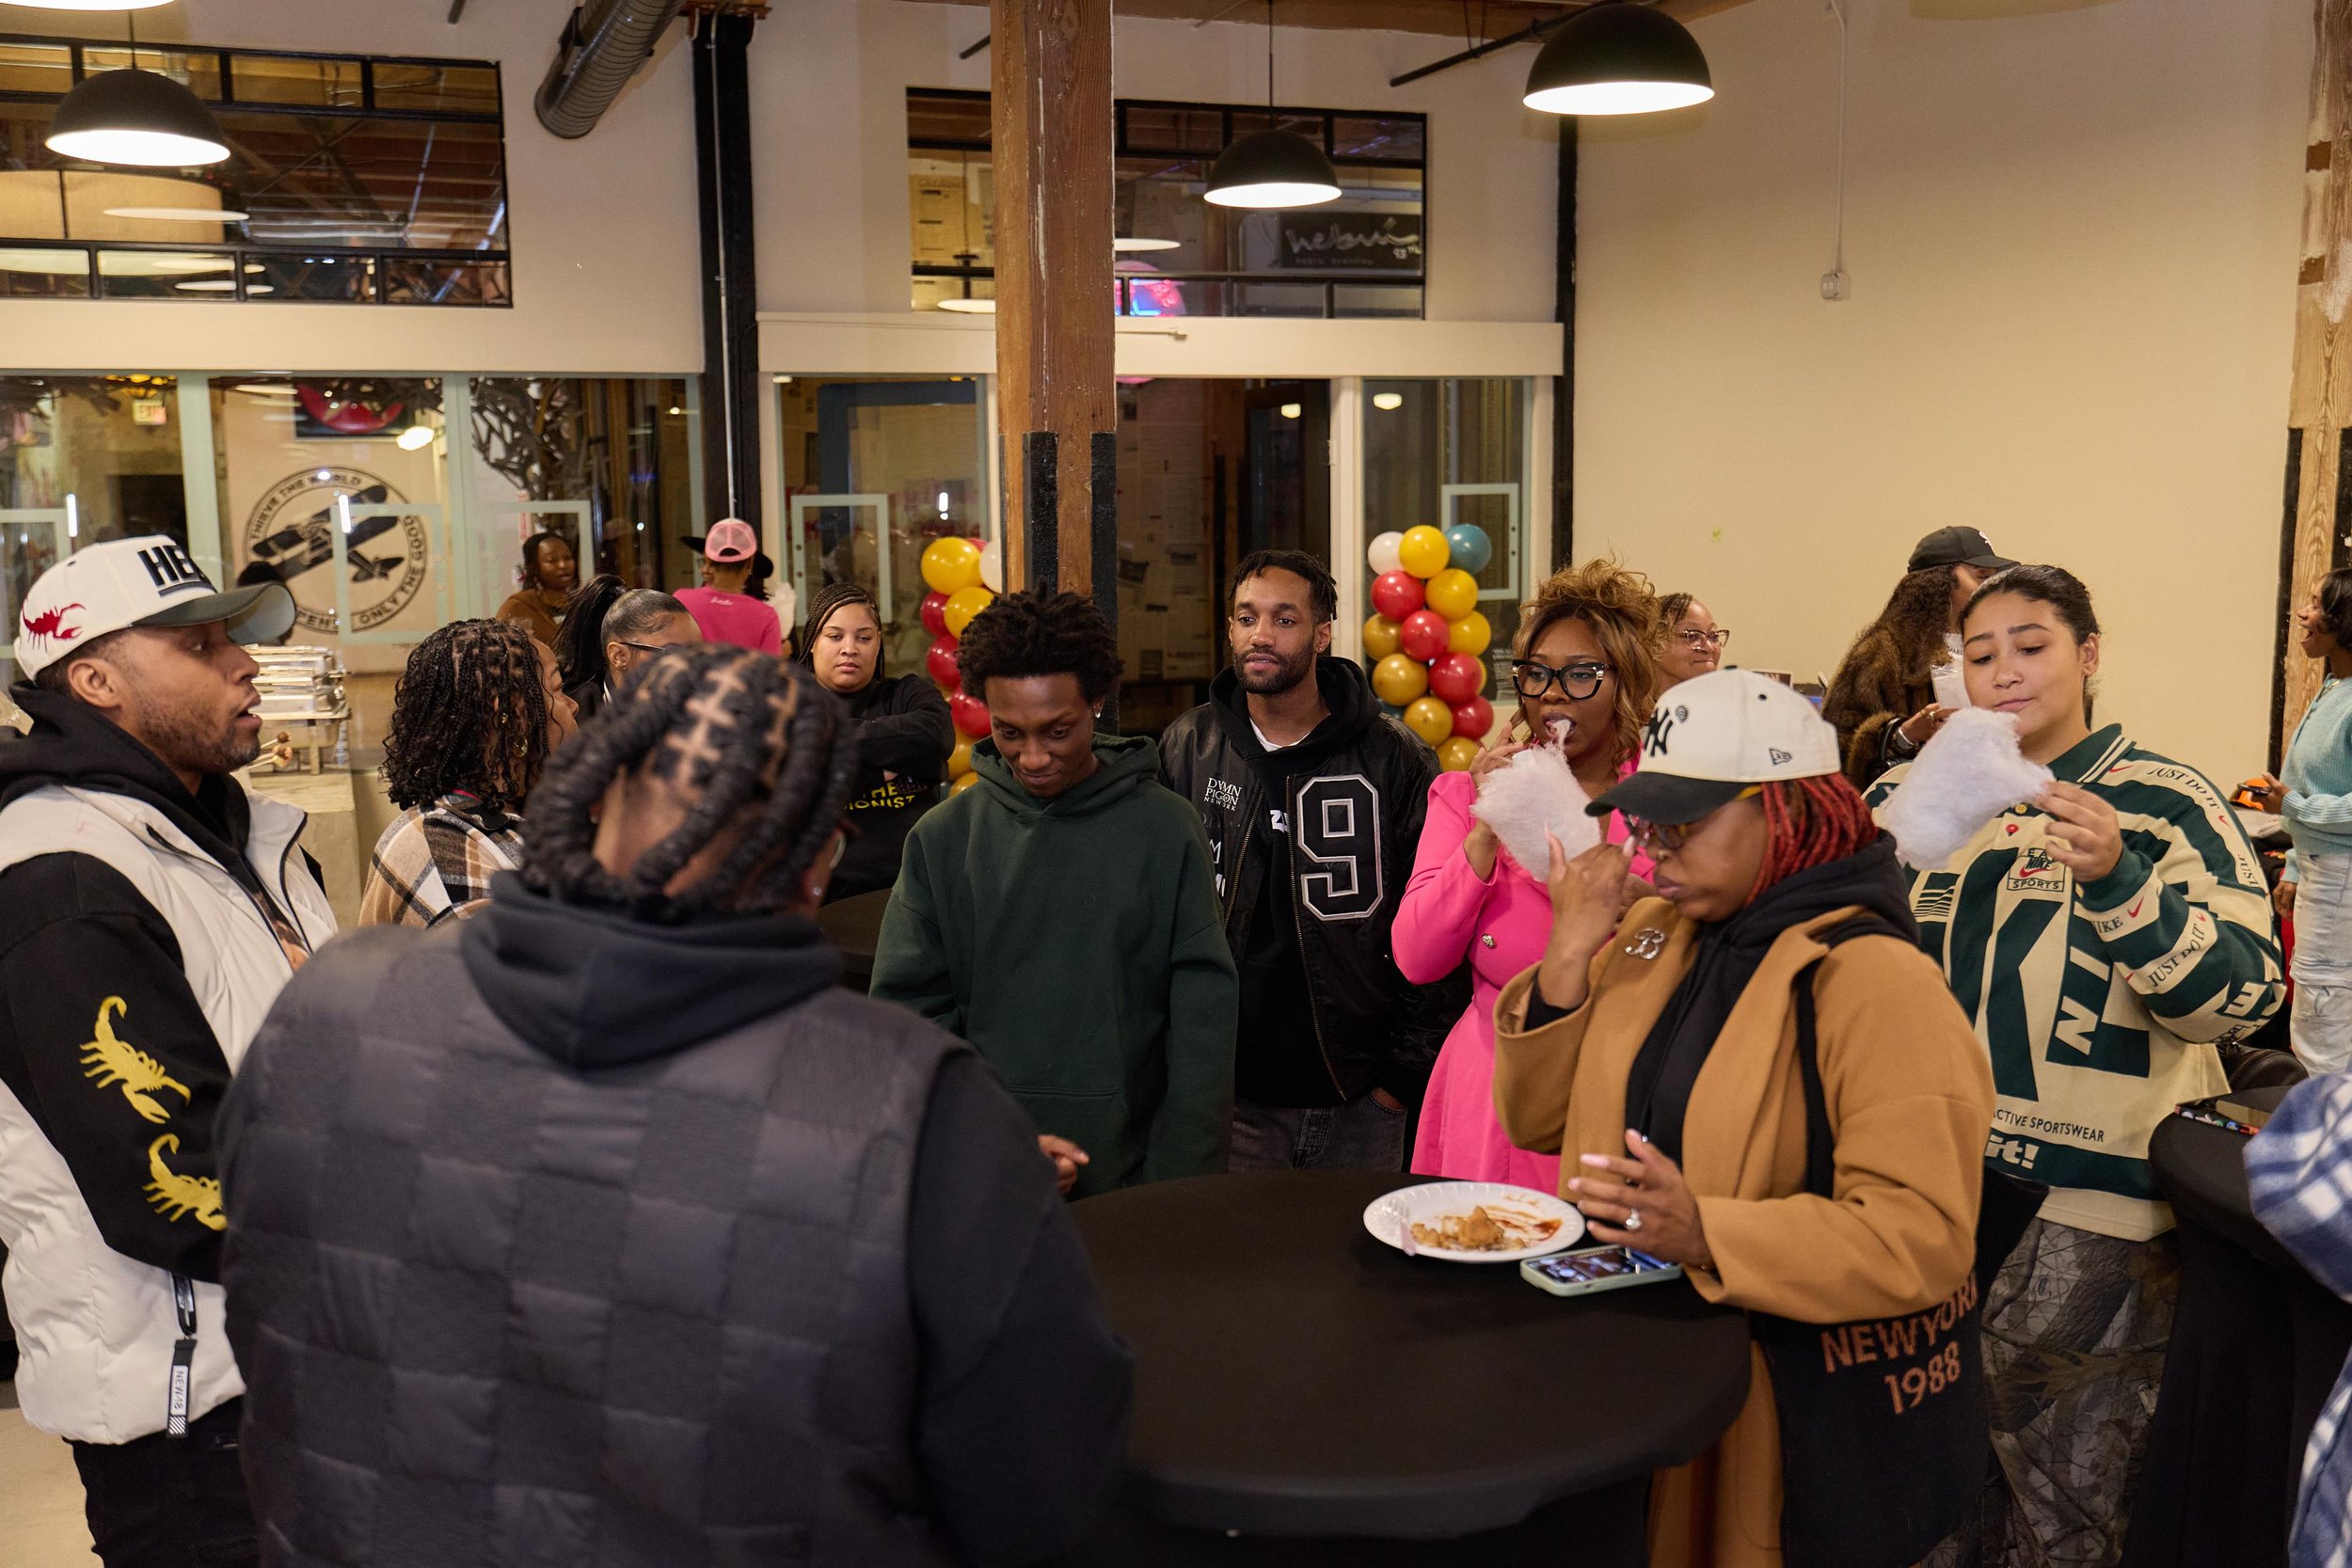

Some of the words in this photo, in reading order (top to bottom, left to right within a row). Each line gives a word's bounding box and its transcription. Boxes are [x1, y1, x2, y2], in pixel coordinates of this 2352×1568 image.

[251, 498, 279, 540] THIEVE
[279, 479, 306, 497] THE
[310, 472, 362, 486] WRLD
[403, 515, 423, 561] GOOD
[397, 565, 422, 596] THE
[359, 597, 400, 625] ONLY
[844, 795, 915, 811] IONIST
[862, 782, 898, 799] HE
[2146, 768, 2186, 787] JUST
[2183, 779, 2208, 797] DO
[2205, 796, 2220, 810] IT
[1296, 774, 1383, 921] 9
[2012, 878, 2059, 890] SPORTS
[2146, 956, 2180, 988] JUST
[1992, 1108, 2027, 1128] CTIVE
[2029, 1117, 2105, 1143] SPORTSWEAR
[1883, 1340, 1962, 1415] 1988
